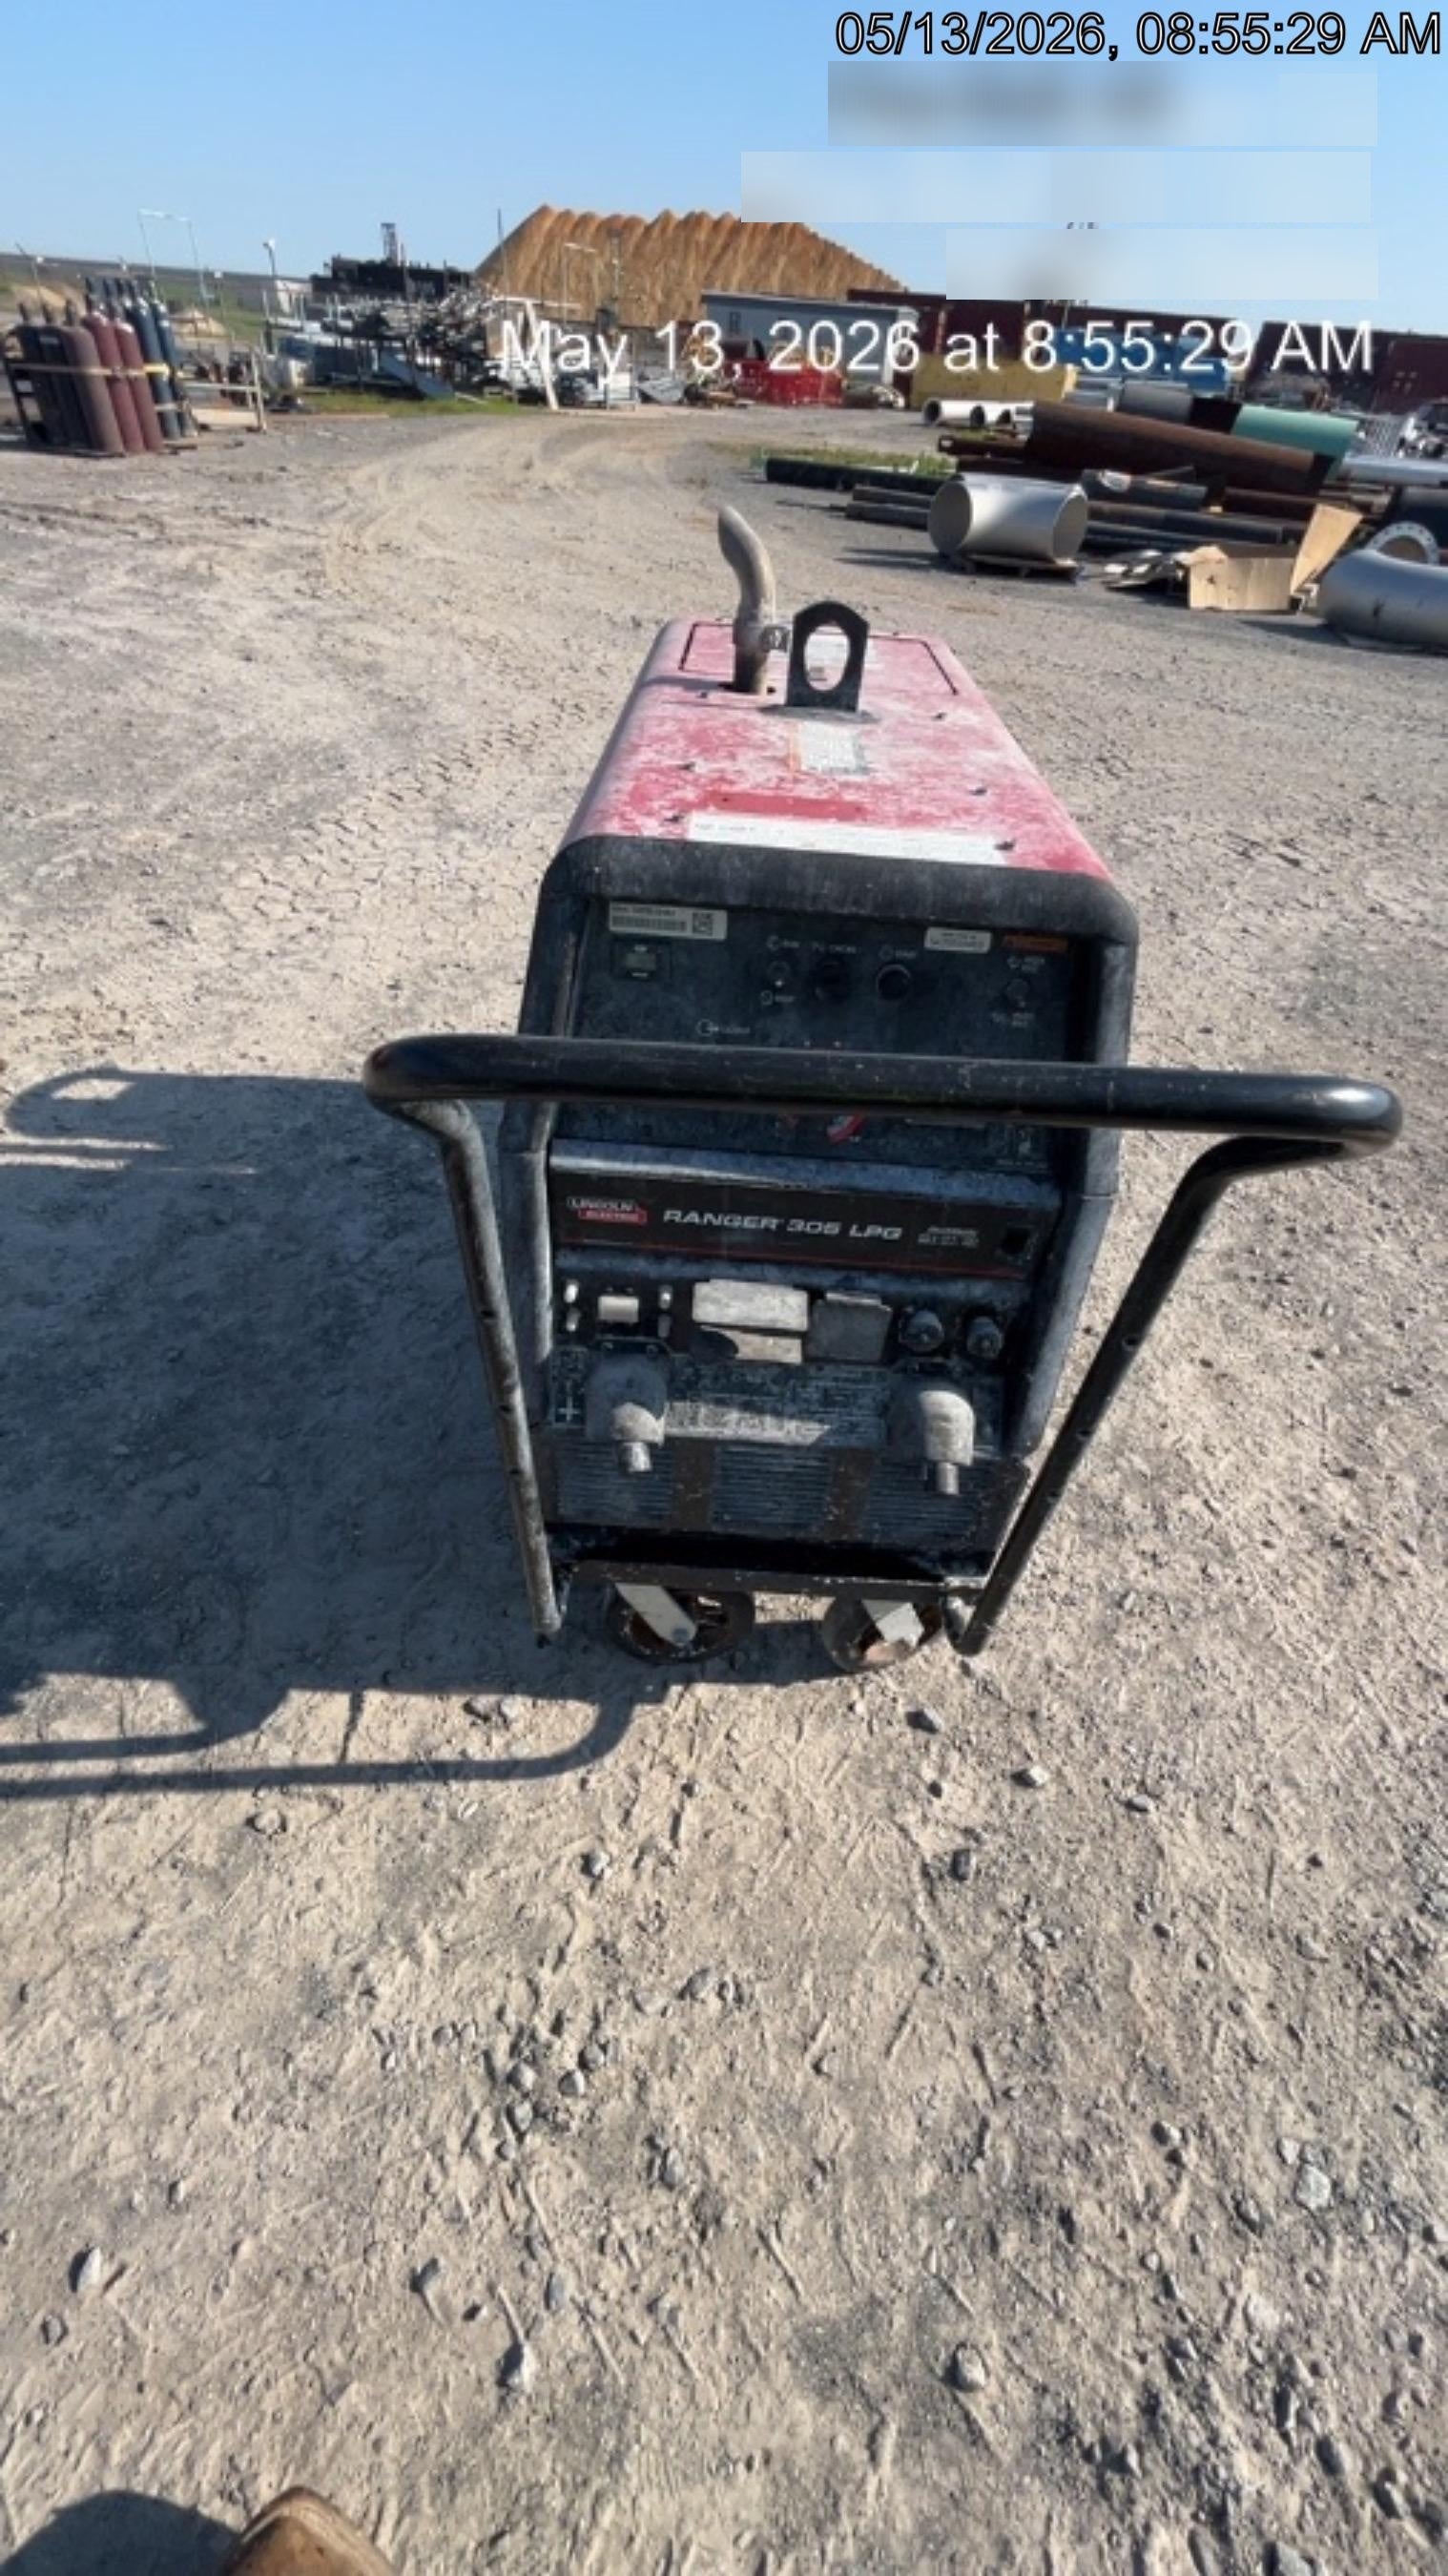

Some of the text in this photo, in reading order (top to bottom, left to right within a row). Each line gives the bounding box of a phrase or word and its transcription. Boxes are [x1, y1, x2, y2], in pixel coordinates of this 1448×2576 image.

[663, 1209, 902, 1240] RANGER 305 LPG
